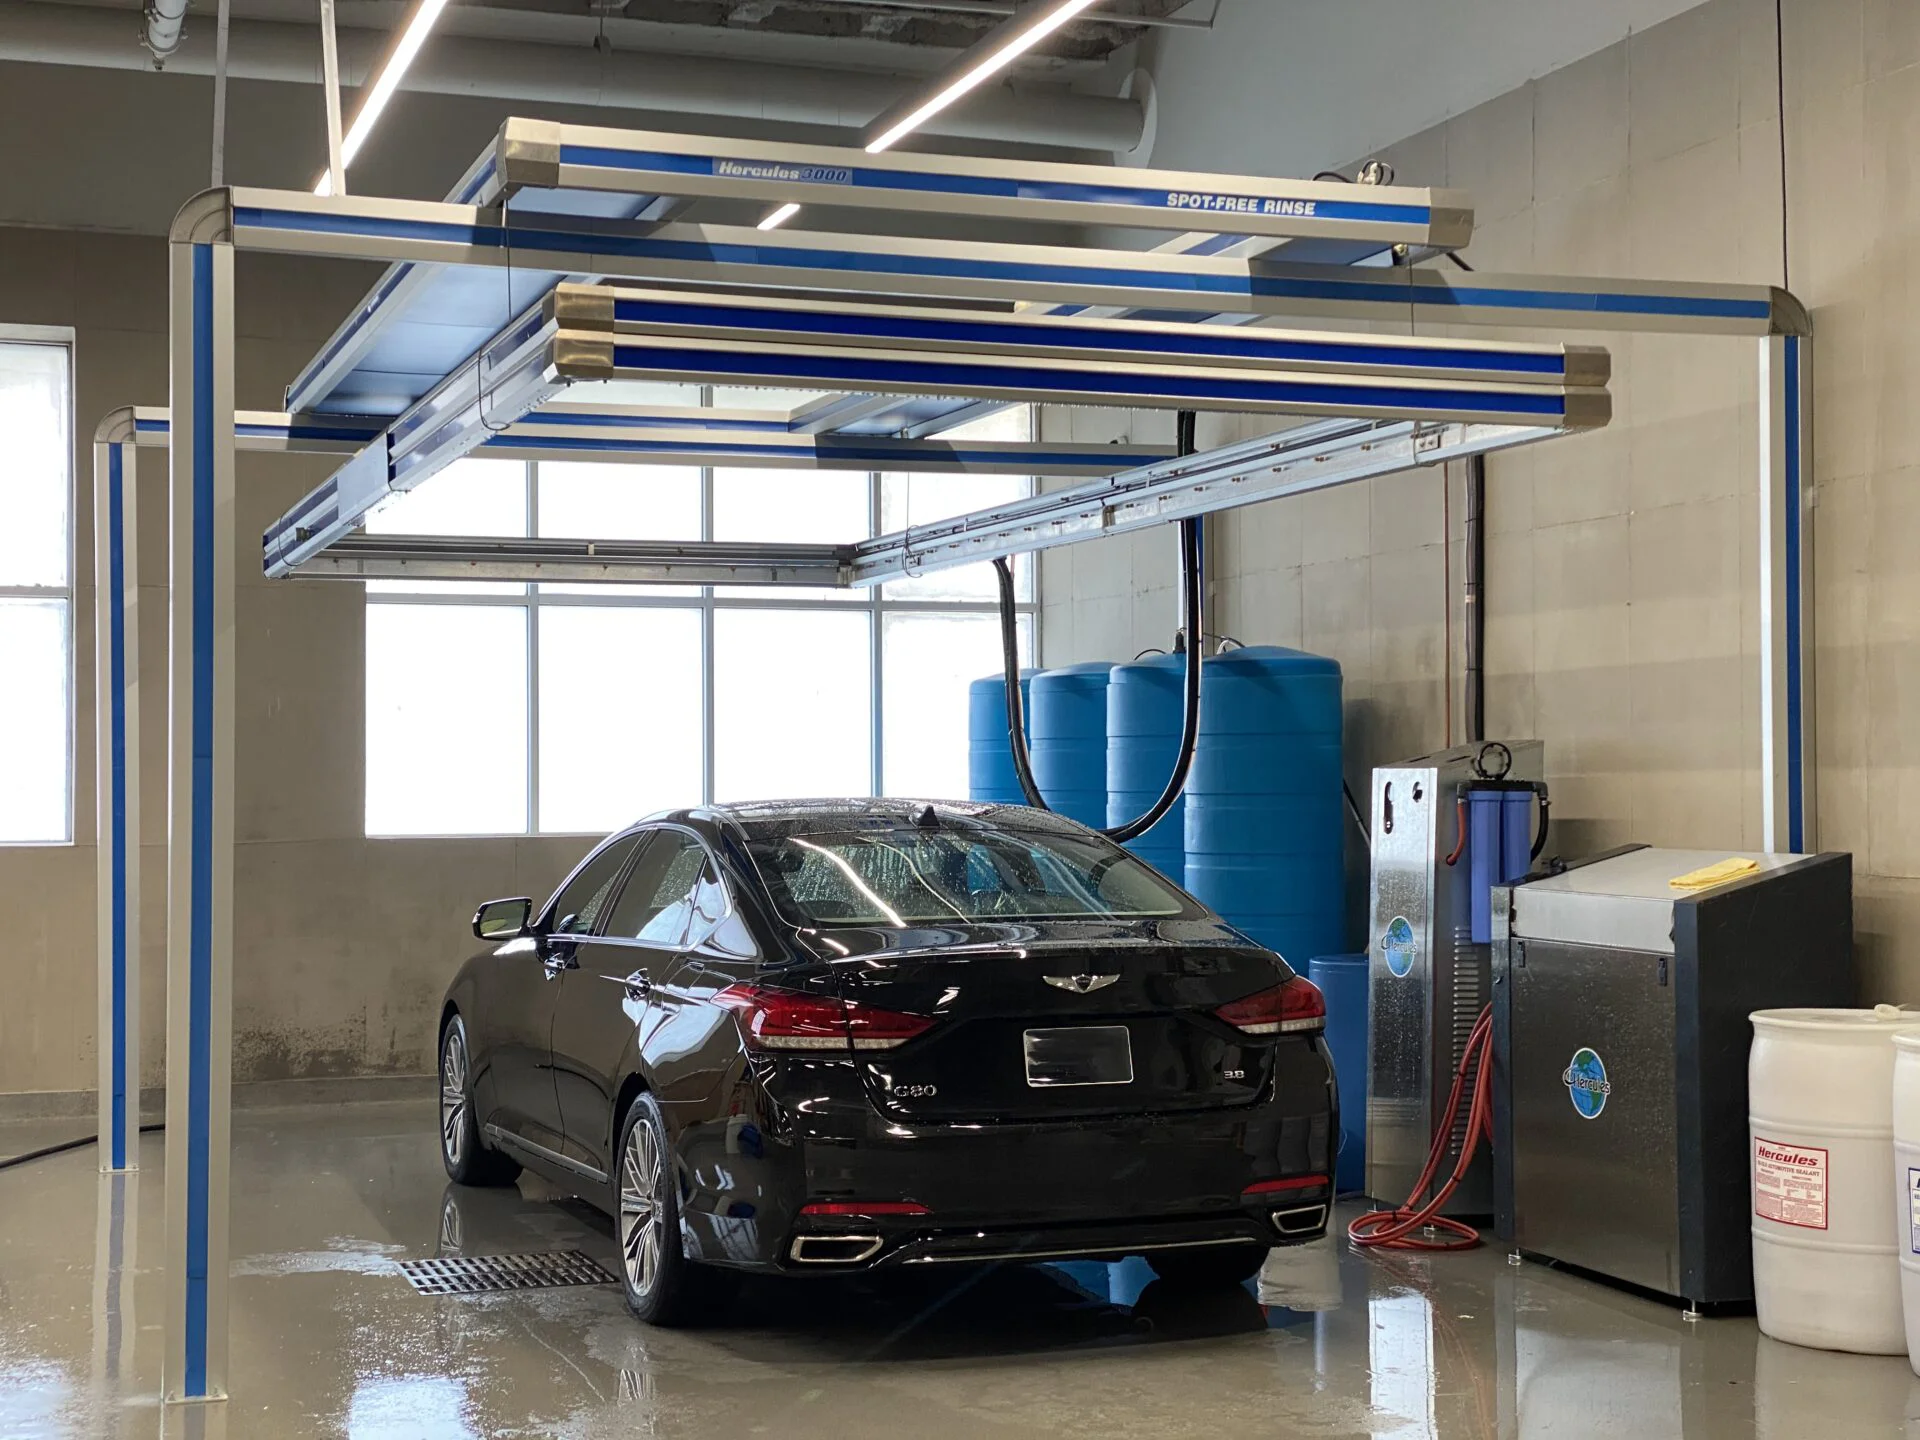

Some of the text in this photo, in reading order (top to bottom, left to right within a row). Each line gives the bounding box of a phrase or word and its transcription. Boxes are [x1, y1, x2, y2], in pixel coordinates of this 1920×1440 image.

[719, 161, 847, 182] Hercules 3000
[1167, 192, 1316, 216] SPOT-FREE RINSE
[893, 1084, 938, 1097] G80
[1758, 1146, 1818, 1167] Hercules
[1796, 1168, 1820, 1177] SEALANT
